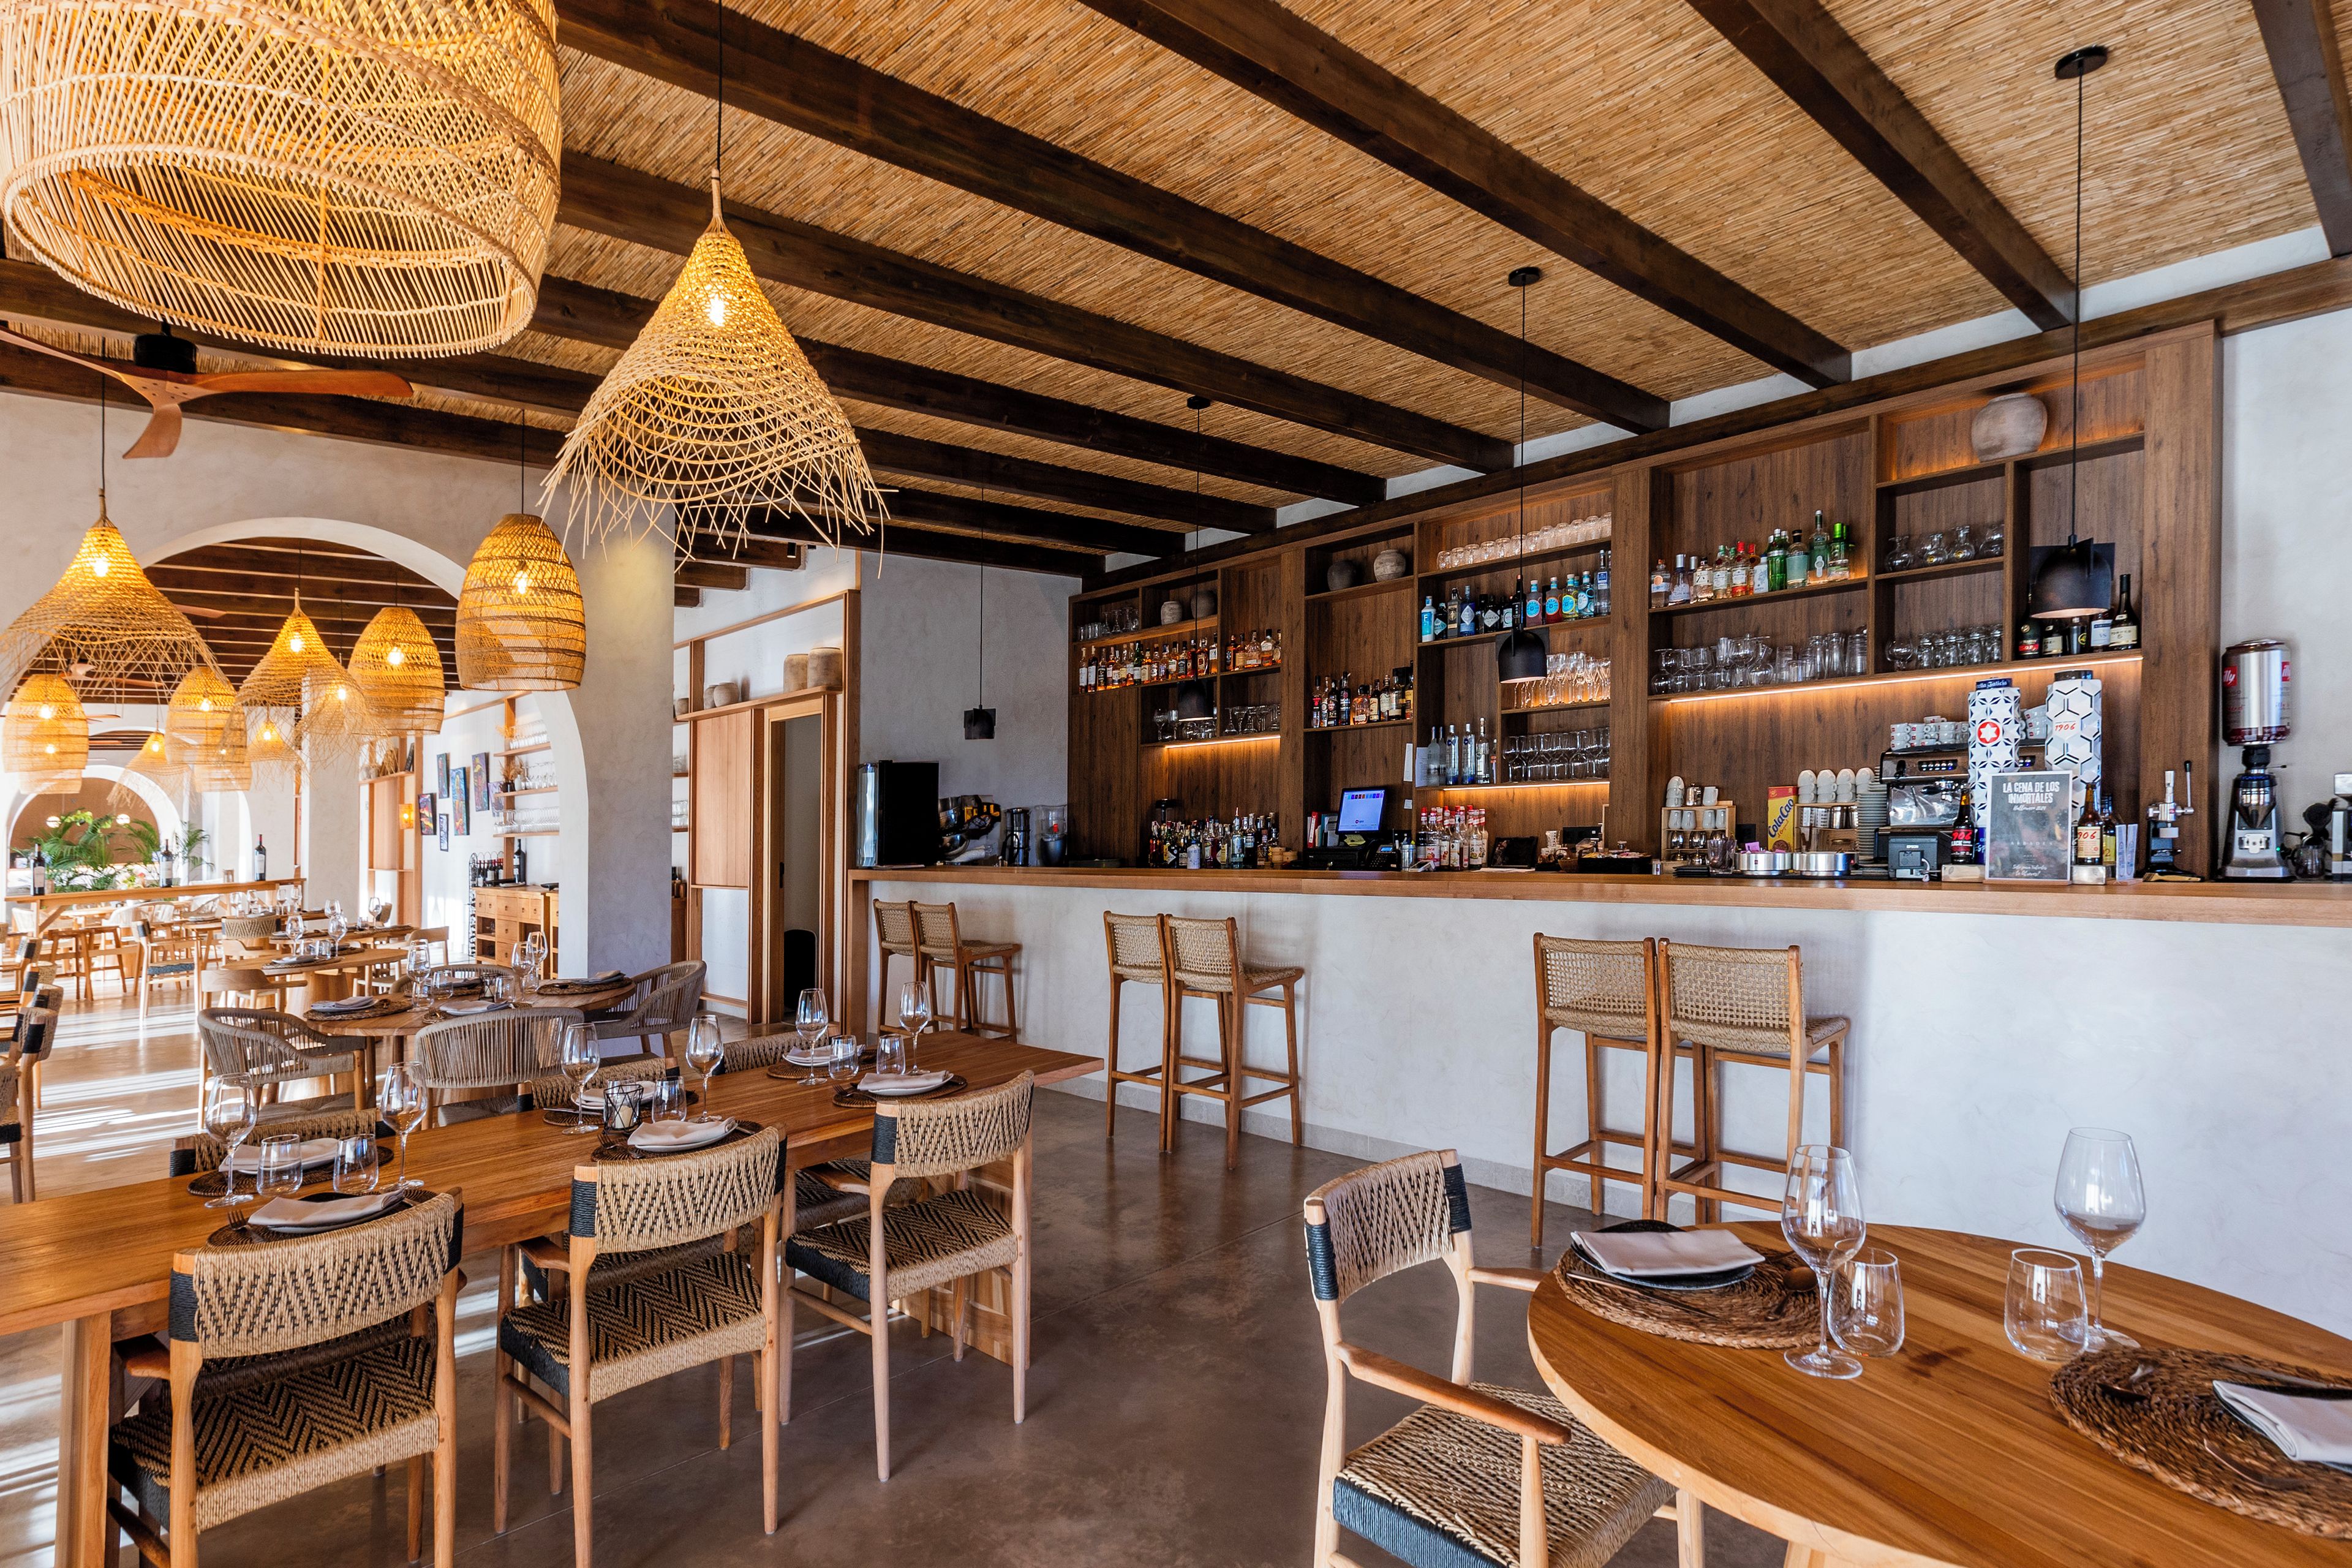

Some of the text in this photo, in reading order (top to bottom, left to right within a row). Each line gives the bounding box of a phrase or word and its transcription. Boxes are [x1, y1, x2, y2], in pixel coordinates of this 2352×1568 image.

[2055, 723, 2076, 731] 1906
[2003, 781, 2060, 793] LA CENA DE LOS
[2008, 793, 2053, 804] INMORTALES
[1768, 799, 1793, 837] ColaCao
